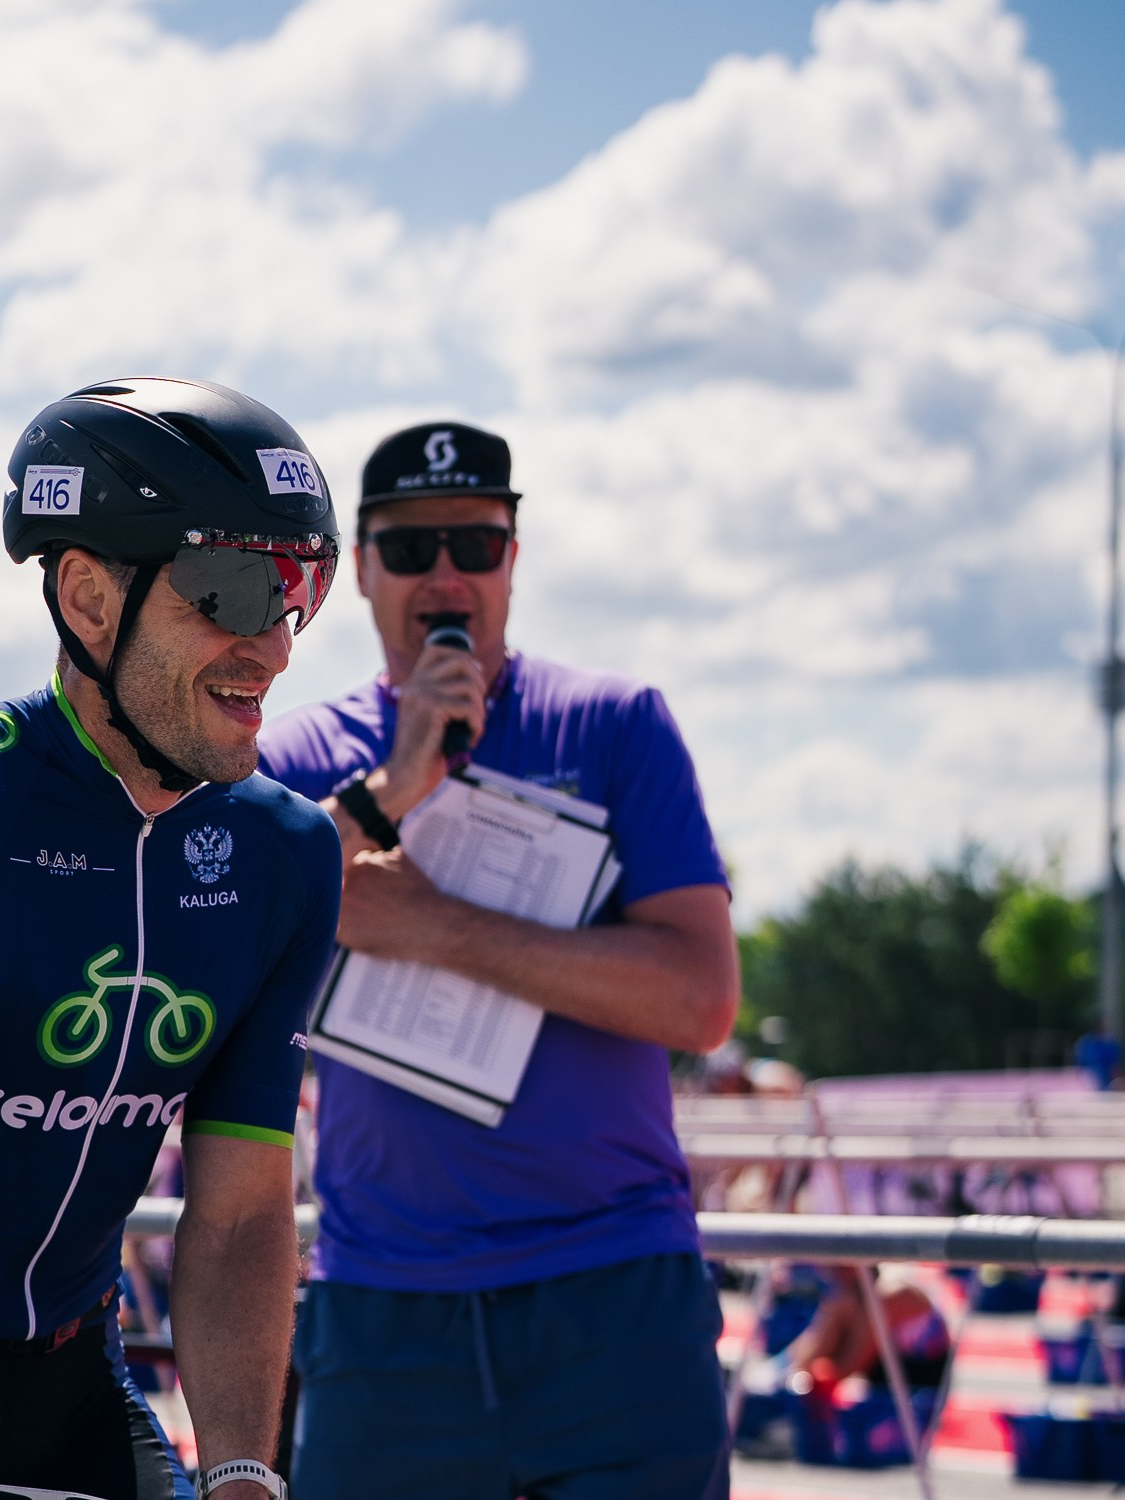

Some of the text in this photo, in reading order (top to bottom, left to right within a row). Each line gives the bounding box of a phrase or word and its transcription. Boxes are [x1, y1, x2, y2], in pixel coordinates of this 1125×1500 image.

[276, 460, 315, 491] 416
[29, 478, 70, 510] 416
[179, 890, 239, 909] KALUGA
